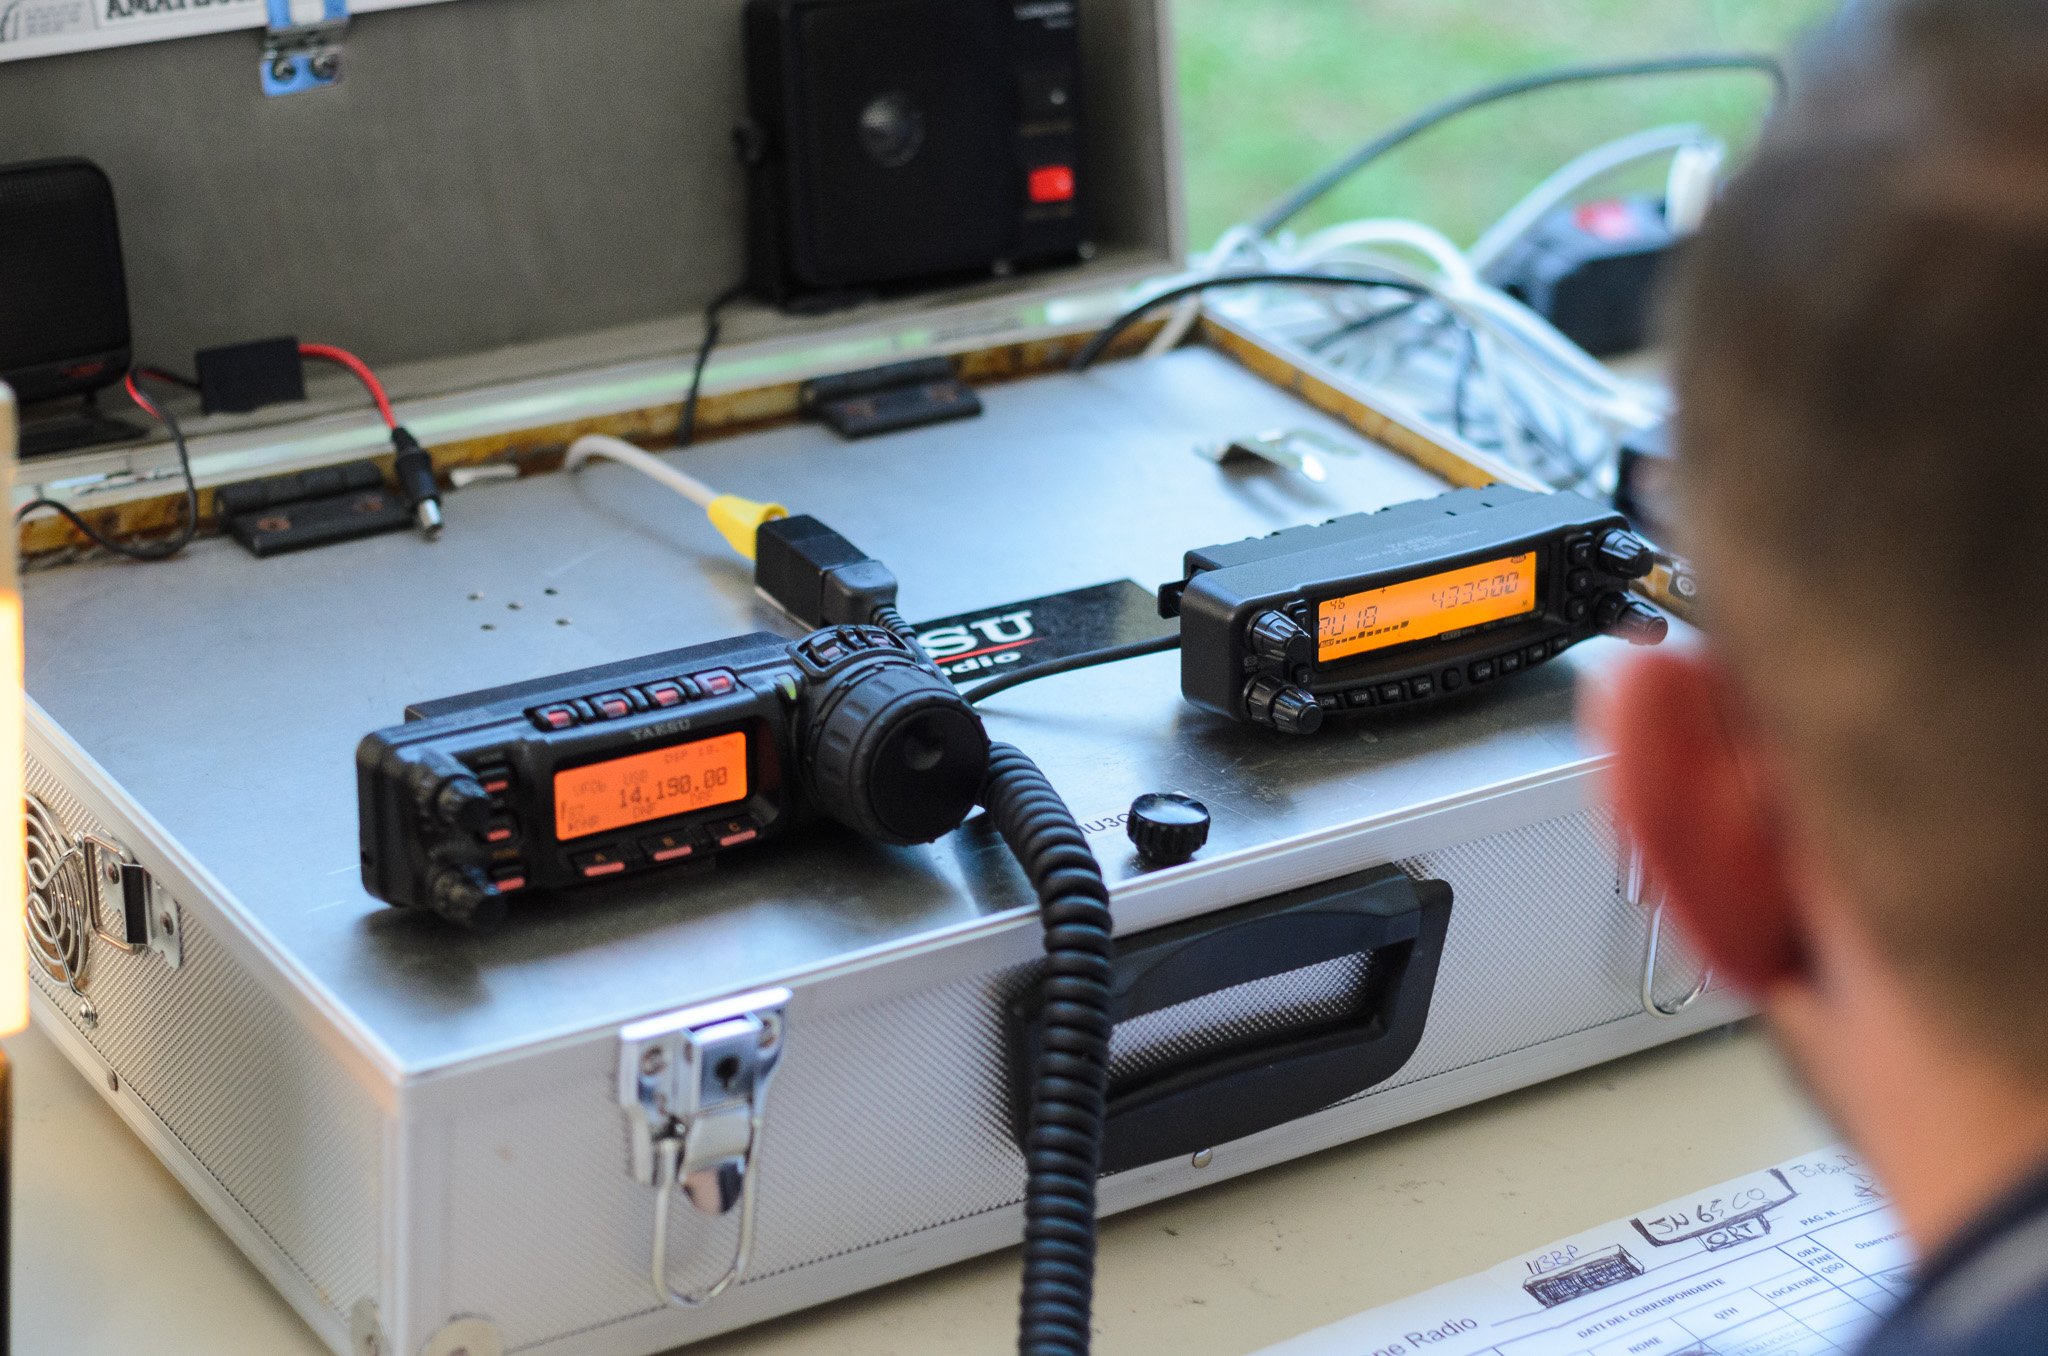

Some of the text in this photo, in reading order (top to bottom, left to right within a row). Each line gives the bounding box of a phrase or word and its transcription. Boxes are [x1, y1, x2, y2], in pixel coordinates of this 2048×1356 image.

[1354, 693, 1368, 703] V/M
[1387, 687, 1399, 697] HM
[1320, 697, 1336, 707] LOW
[629, 718, 691, 741] YAESU
[1797, 1245, 1822, 1259] ORA
[1807, 1253, 1835, 1268] FINE
[1820, 1261, 1845, 1275] QSO
[1765, 1274, 1823, 1300] LOCATORE
[1577, 1277, 1726, 1339] DATI DEL CORRISPONDENTE
[1713, 1305, 1740, 1321] QTH
[1403, 1317, 1478, 1349] Radio
[1627, 1335, 1664, 1354] NOME
